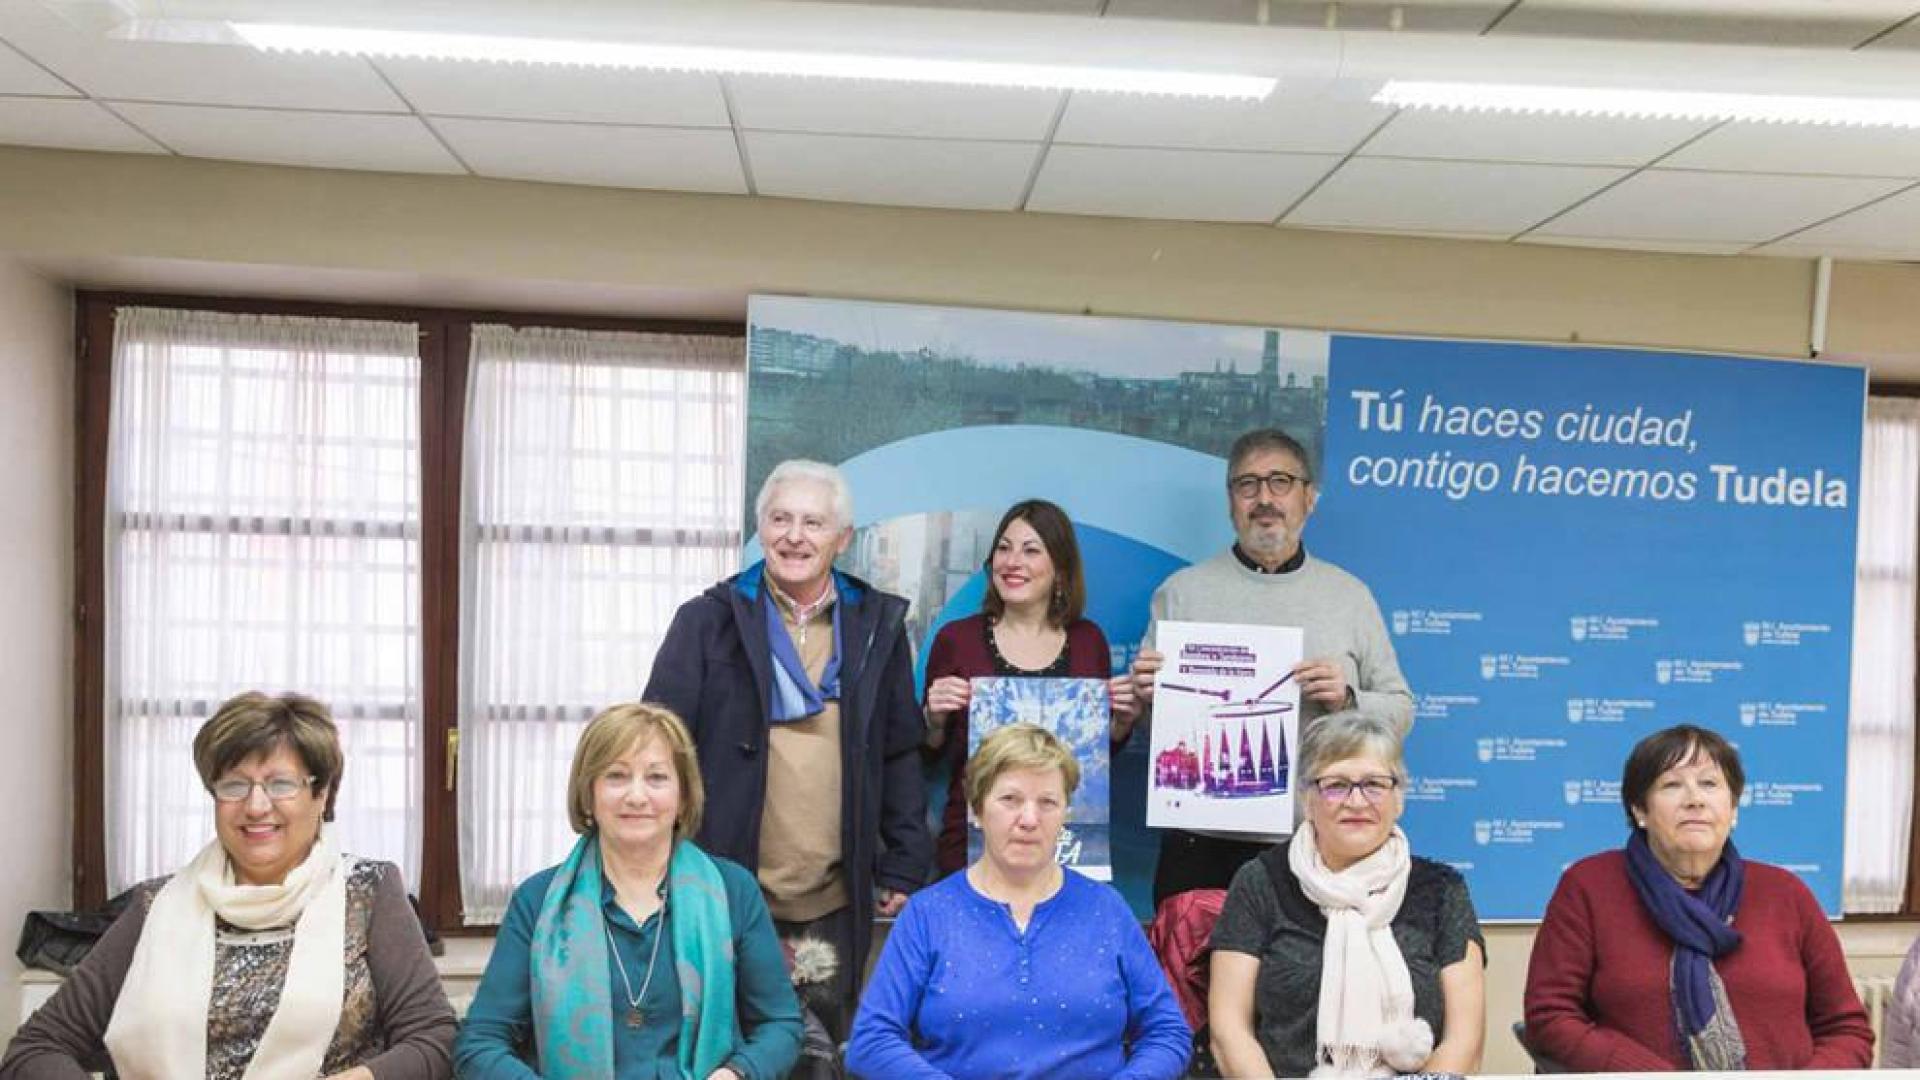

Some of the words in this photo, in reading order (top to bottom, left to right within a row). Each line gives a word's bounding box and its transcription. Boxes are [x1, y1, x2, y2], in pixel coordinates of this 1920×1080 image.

[1351, 389, 1404, 432] Tú
[1418, 395, 1545, 439] haces
[1556, 403, 1697, 453] ciudad,
[1349, 451, 1499, 500] contigo
[1512, 454, 1698, 500] hacemos
[1709, 464, 1848, 507] Tudela
